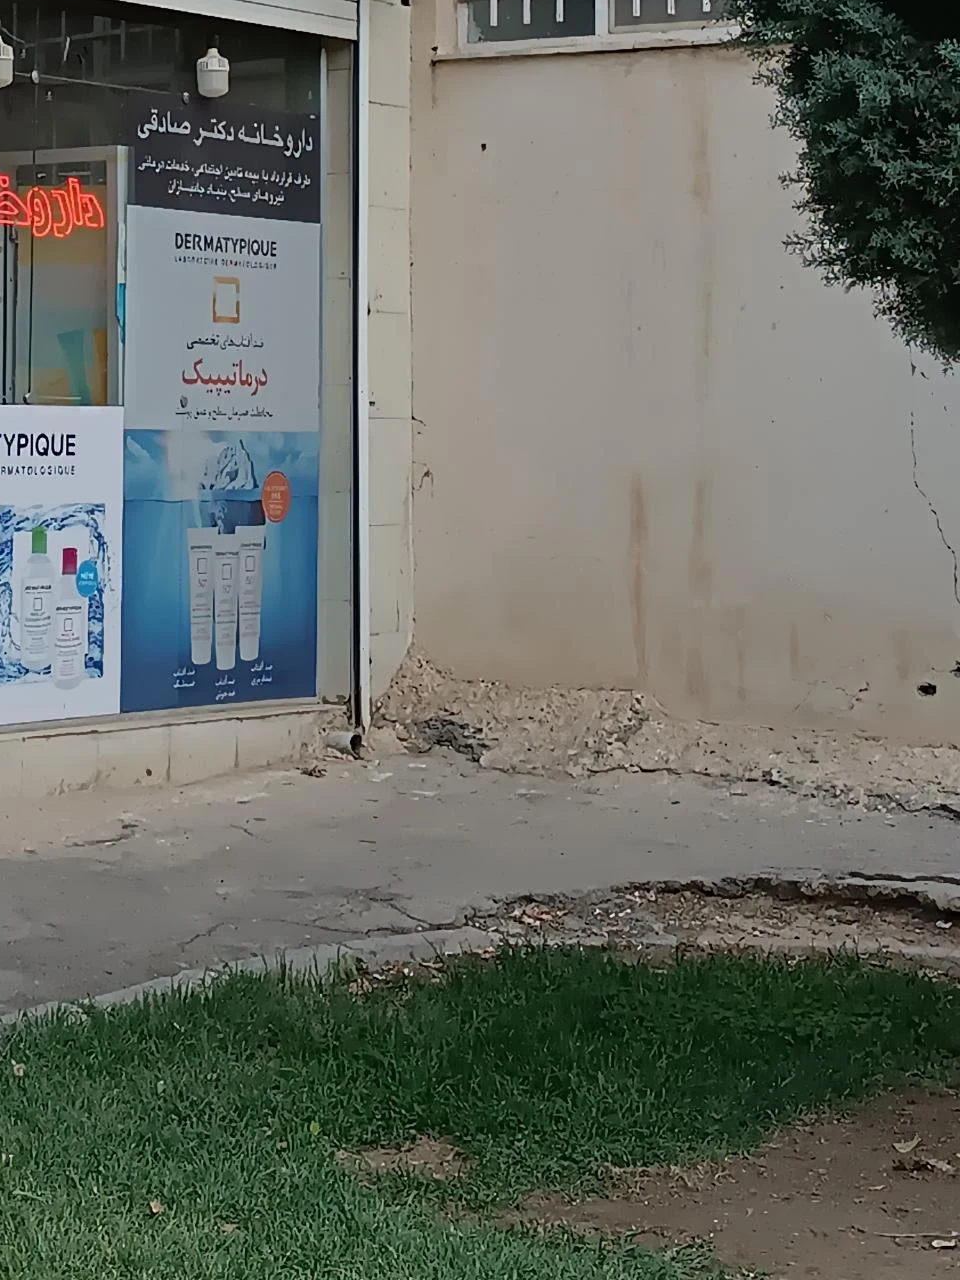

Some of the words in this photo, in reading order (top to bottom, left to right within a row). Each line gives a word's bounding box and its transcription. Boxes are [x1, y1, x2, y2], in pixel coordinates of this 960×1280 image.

[137, 108, 191, 139] صادقی
[193, 118, 235, 147] دکتر
[237, 121, 313, 158] داروخانه
[174, 232, 277, 257] DERMATYPIQUE
[182, 358, 268, 396] درماتیپیک
